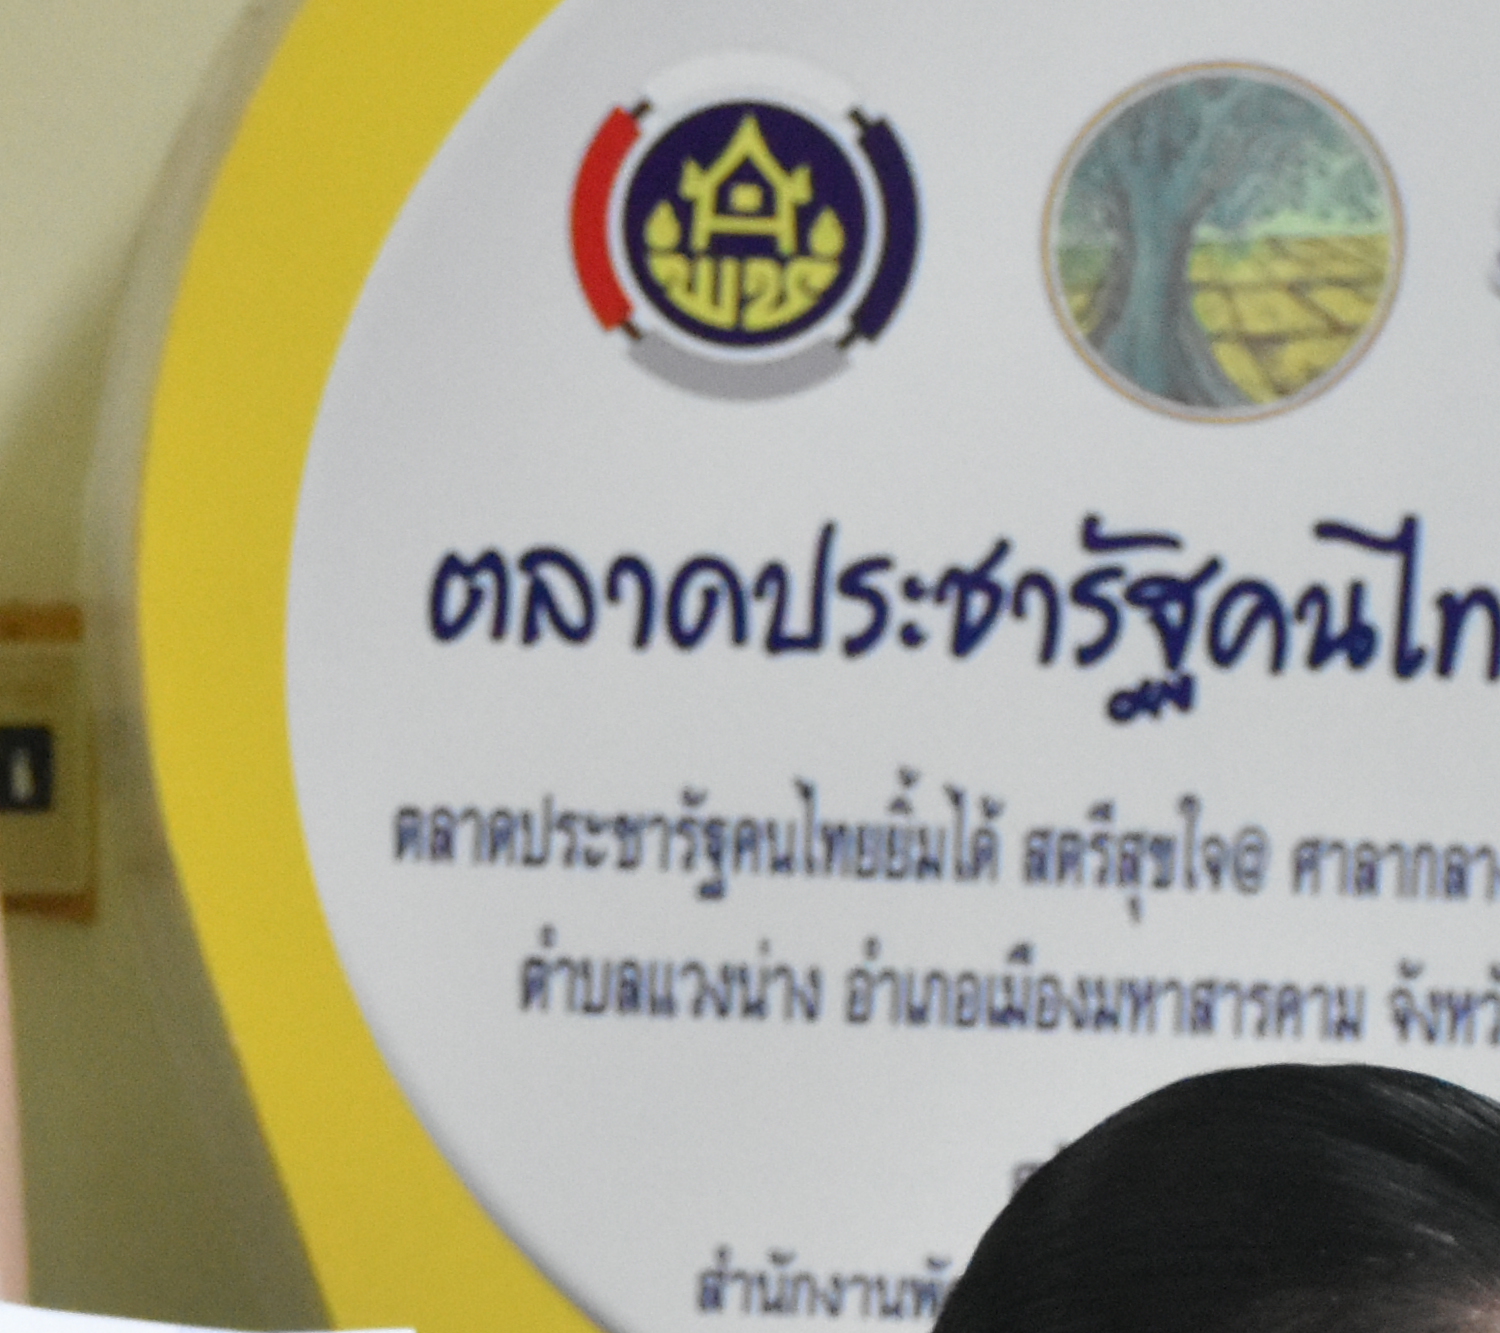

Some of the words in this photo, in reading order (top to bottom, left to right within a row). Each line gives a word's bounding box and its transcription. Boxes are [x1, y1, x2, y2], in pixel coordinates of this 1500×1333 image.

[392, 765, 1005, 903] ตลาดประชารัฐคนไทยยิ้มได้
[843, 934, 1365, 1041] อำเภอเมืองมหาสารคาม
[695, 1243, 960, 1321] สำนักงานพั
